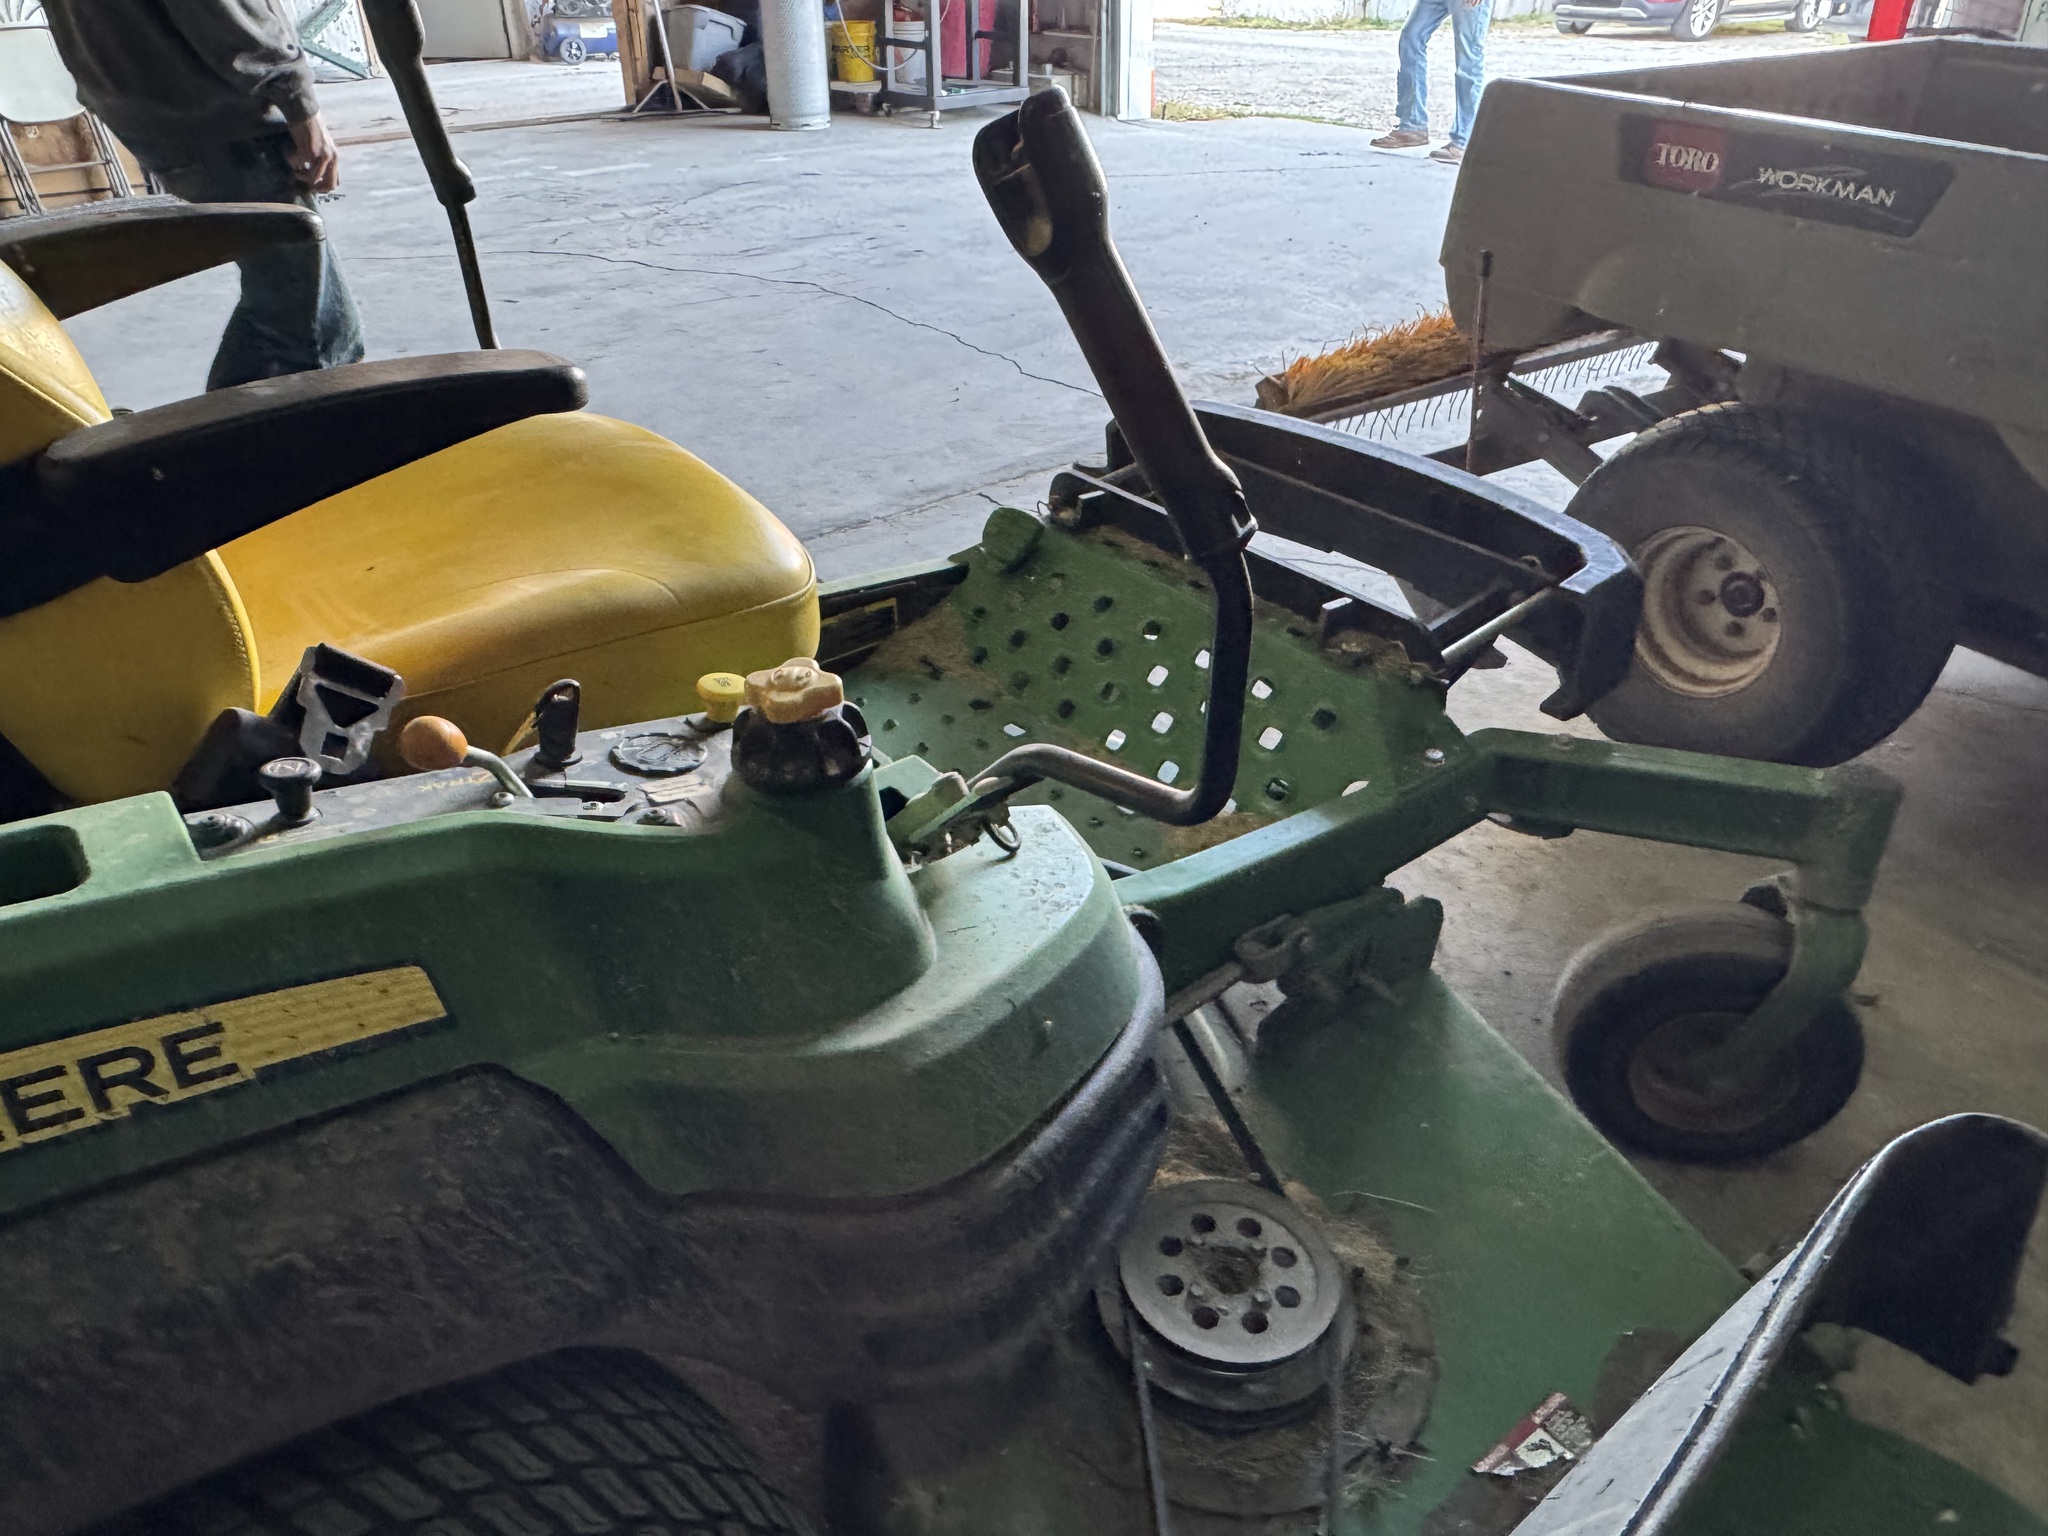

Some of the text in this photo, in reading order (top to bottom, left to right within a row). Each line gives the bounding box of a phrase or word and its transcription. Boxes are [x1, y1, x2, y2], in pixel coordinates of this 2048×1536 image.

[1655, 142, 1720, 173] TORO
[1757, 166, 1896, 208] WORKMAN
[0, 1021, 240, 1142] ERE
